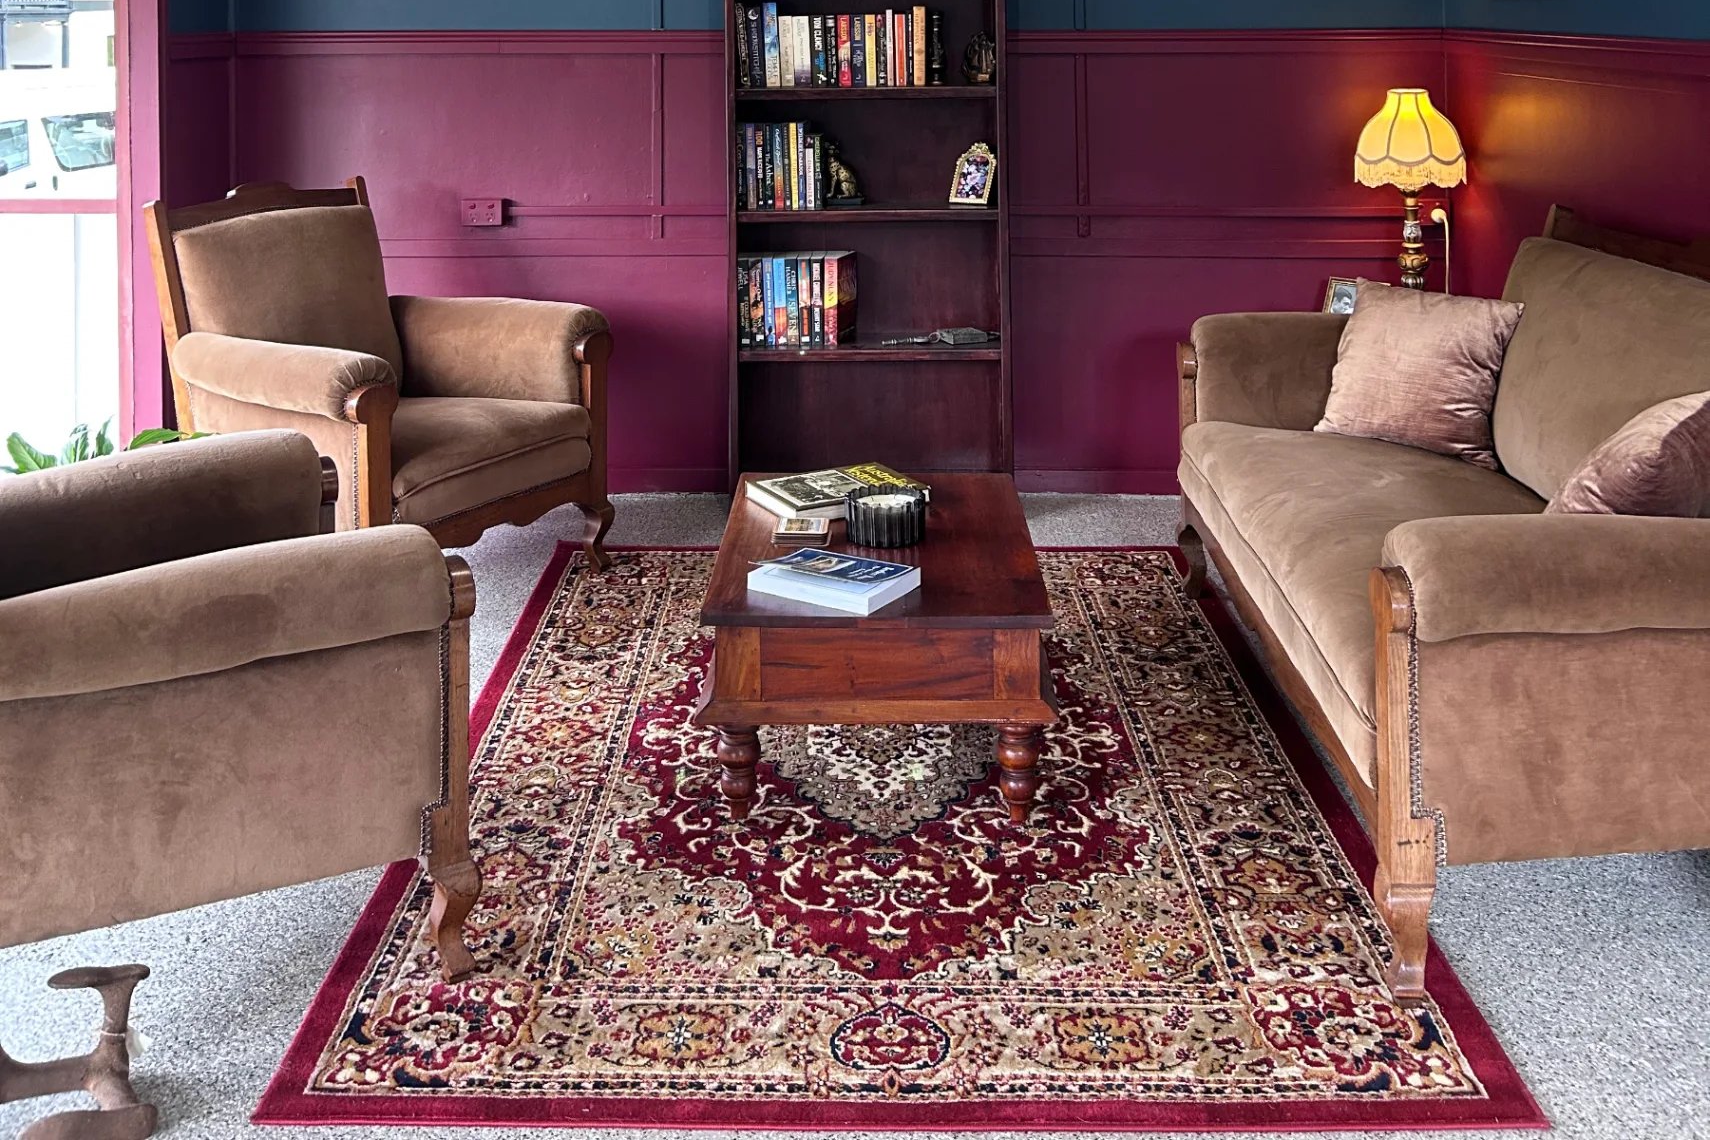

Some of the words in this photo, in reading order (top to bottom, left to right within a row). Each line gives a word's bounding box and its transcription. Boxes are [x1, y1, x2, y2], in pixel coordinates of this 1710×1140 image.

[813, 17, 821, 29] TOM
[840, 17, 848, 40] LARSSON
[814, 30, 822, 51] CLANCY
[788, 301, 796, 333] SEVEN
